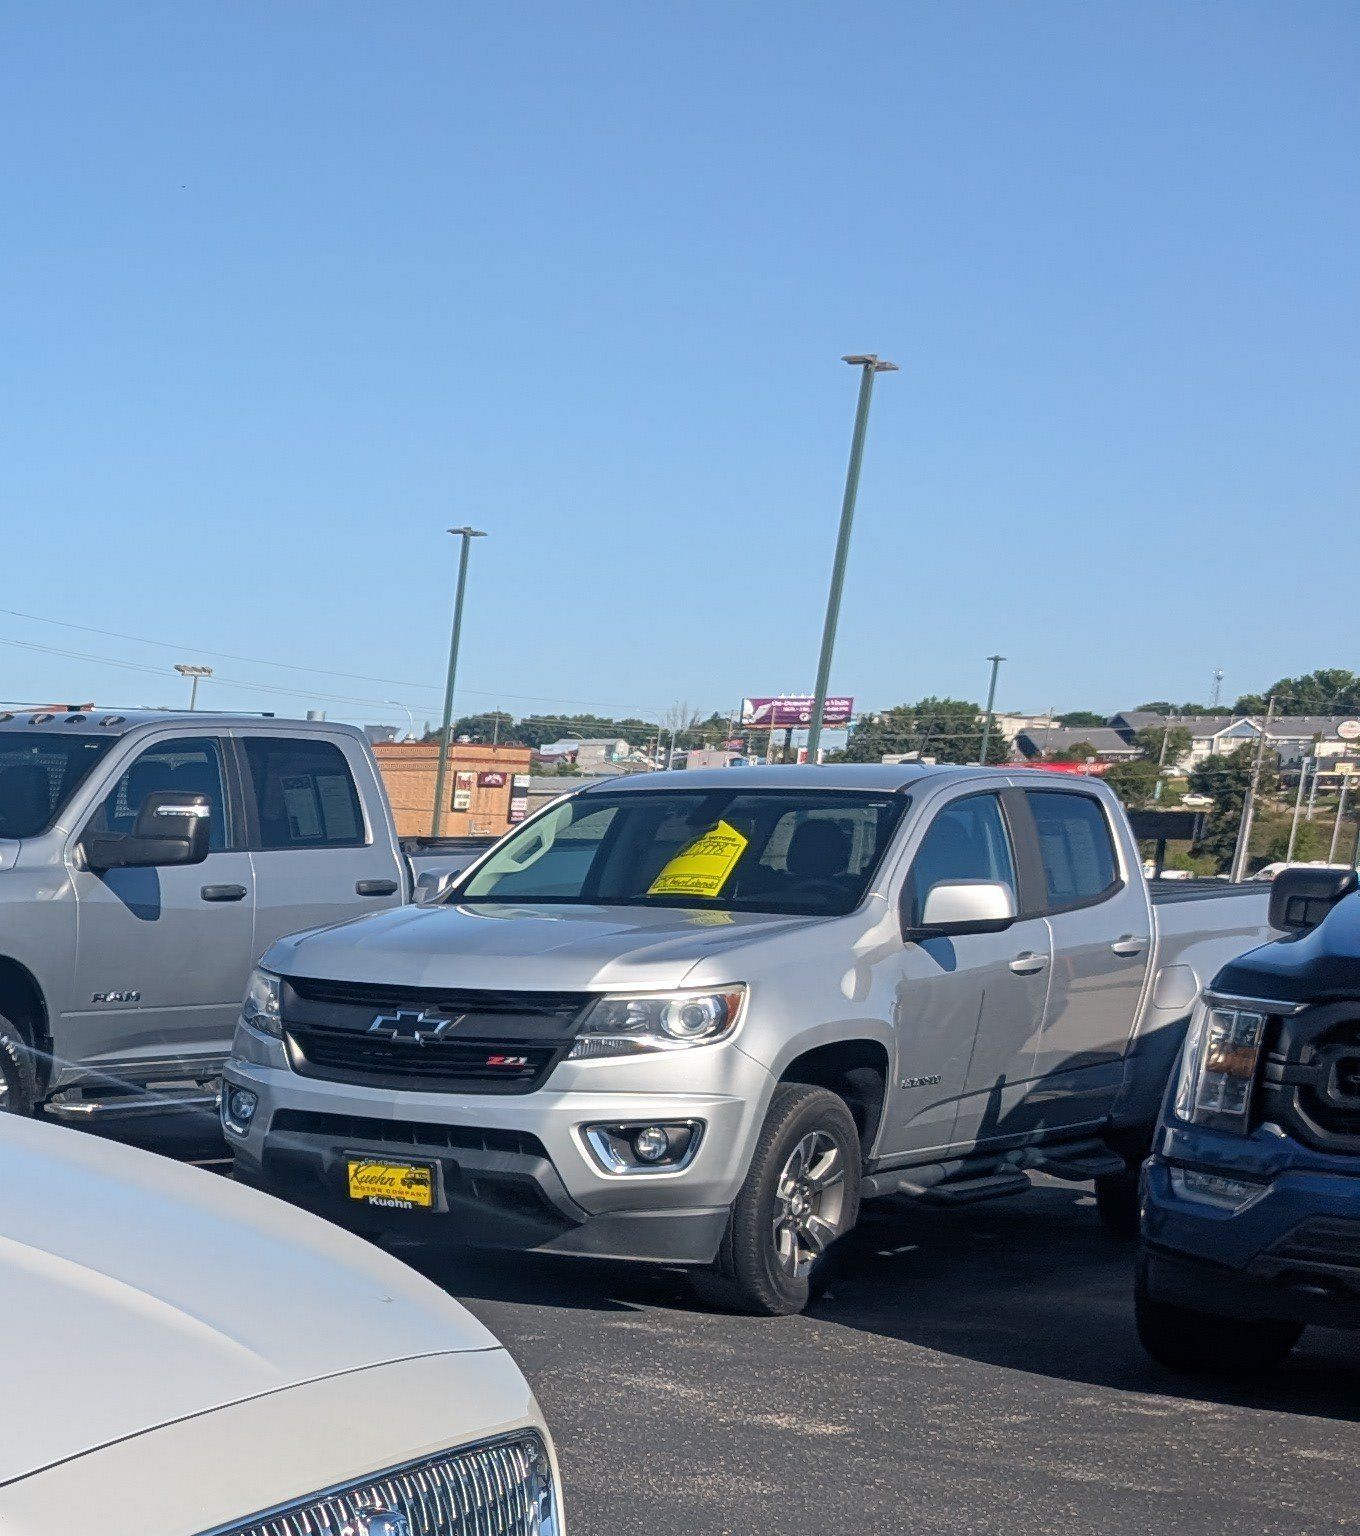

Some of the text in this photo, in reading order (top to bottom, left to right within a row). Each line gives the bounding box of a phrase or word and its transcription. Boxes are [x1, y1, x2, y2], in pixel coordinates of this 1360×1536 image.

[486, 1056, 527, 1066] Z71
[350, 1165, 395, 1186] Kuehn
[386, 1188, 427, 1198] COMPANY
[369, 1196, 412, 1209] Kuehn
